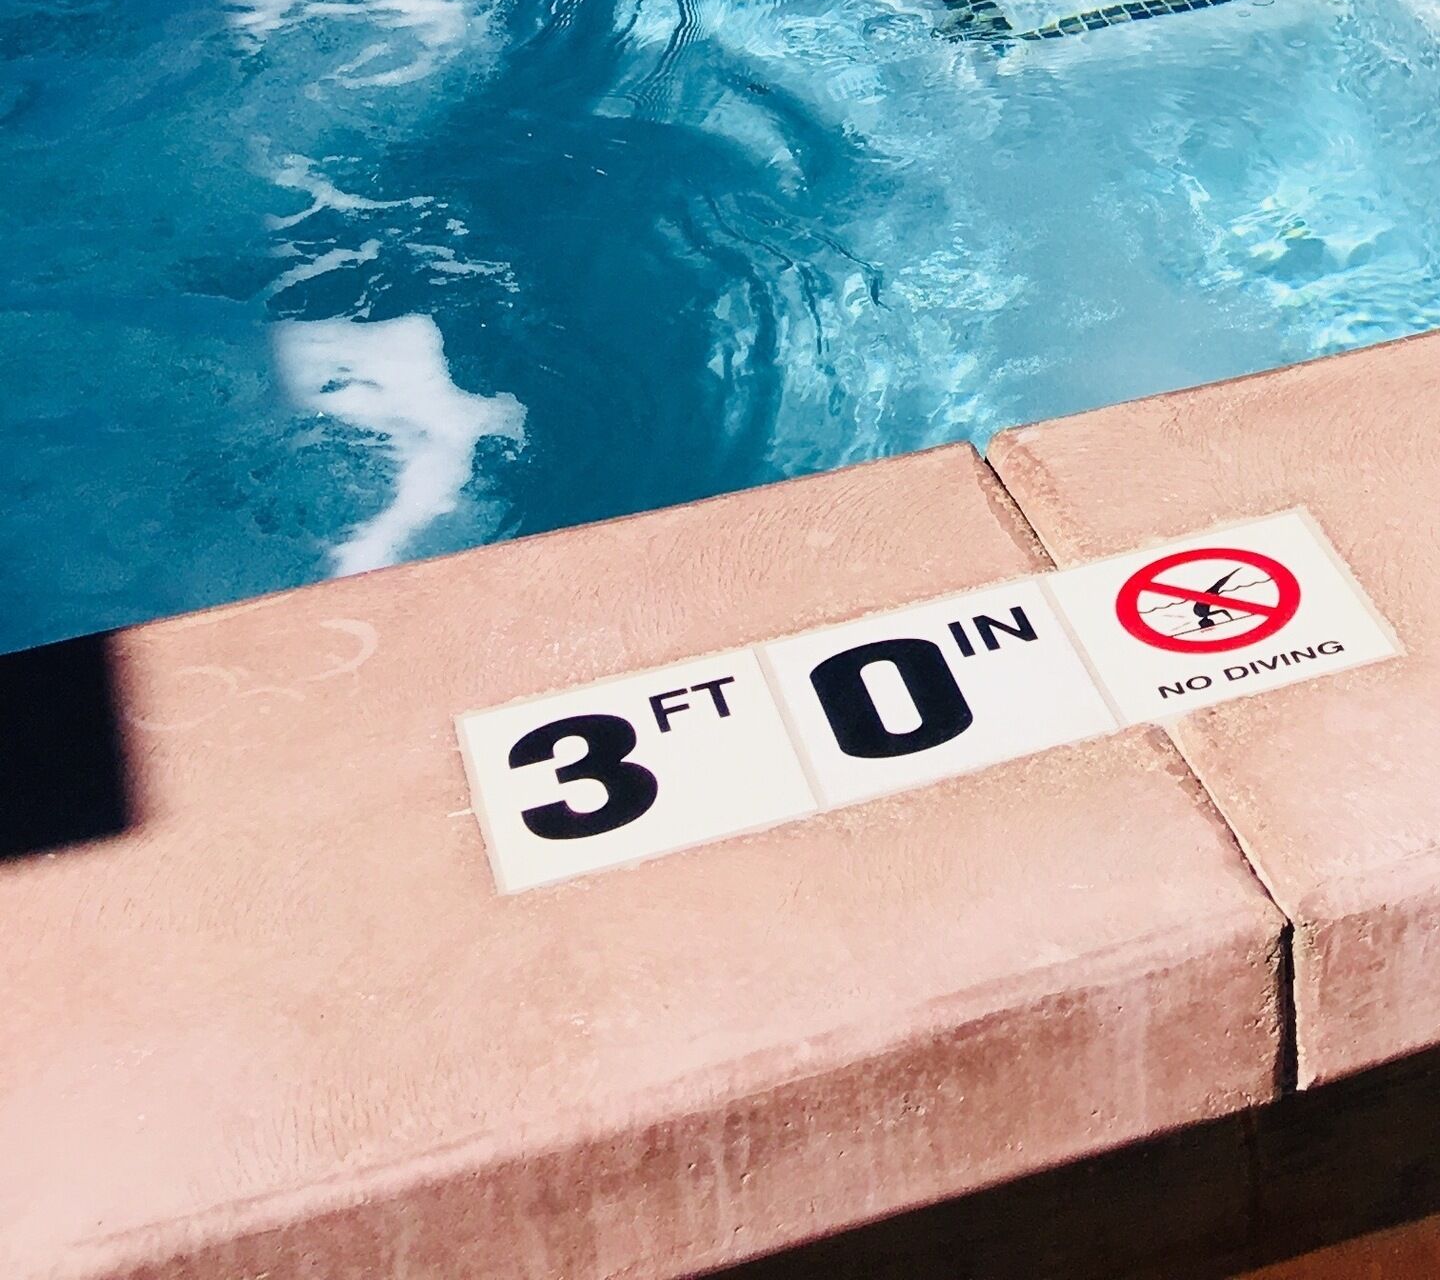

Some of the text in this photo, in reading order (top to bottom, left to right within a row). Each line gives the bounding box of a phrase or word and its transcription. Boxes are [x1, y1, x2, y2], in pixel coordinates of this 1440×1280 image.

[507, 604, 1039, 841] 3 FT 0 IN
[1156, 638, 1347, 701] NO DIVING
